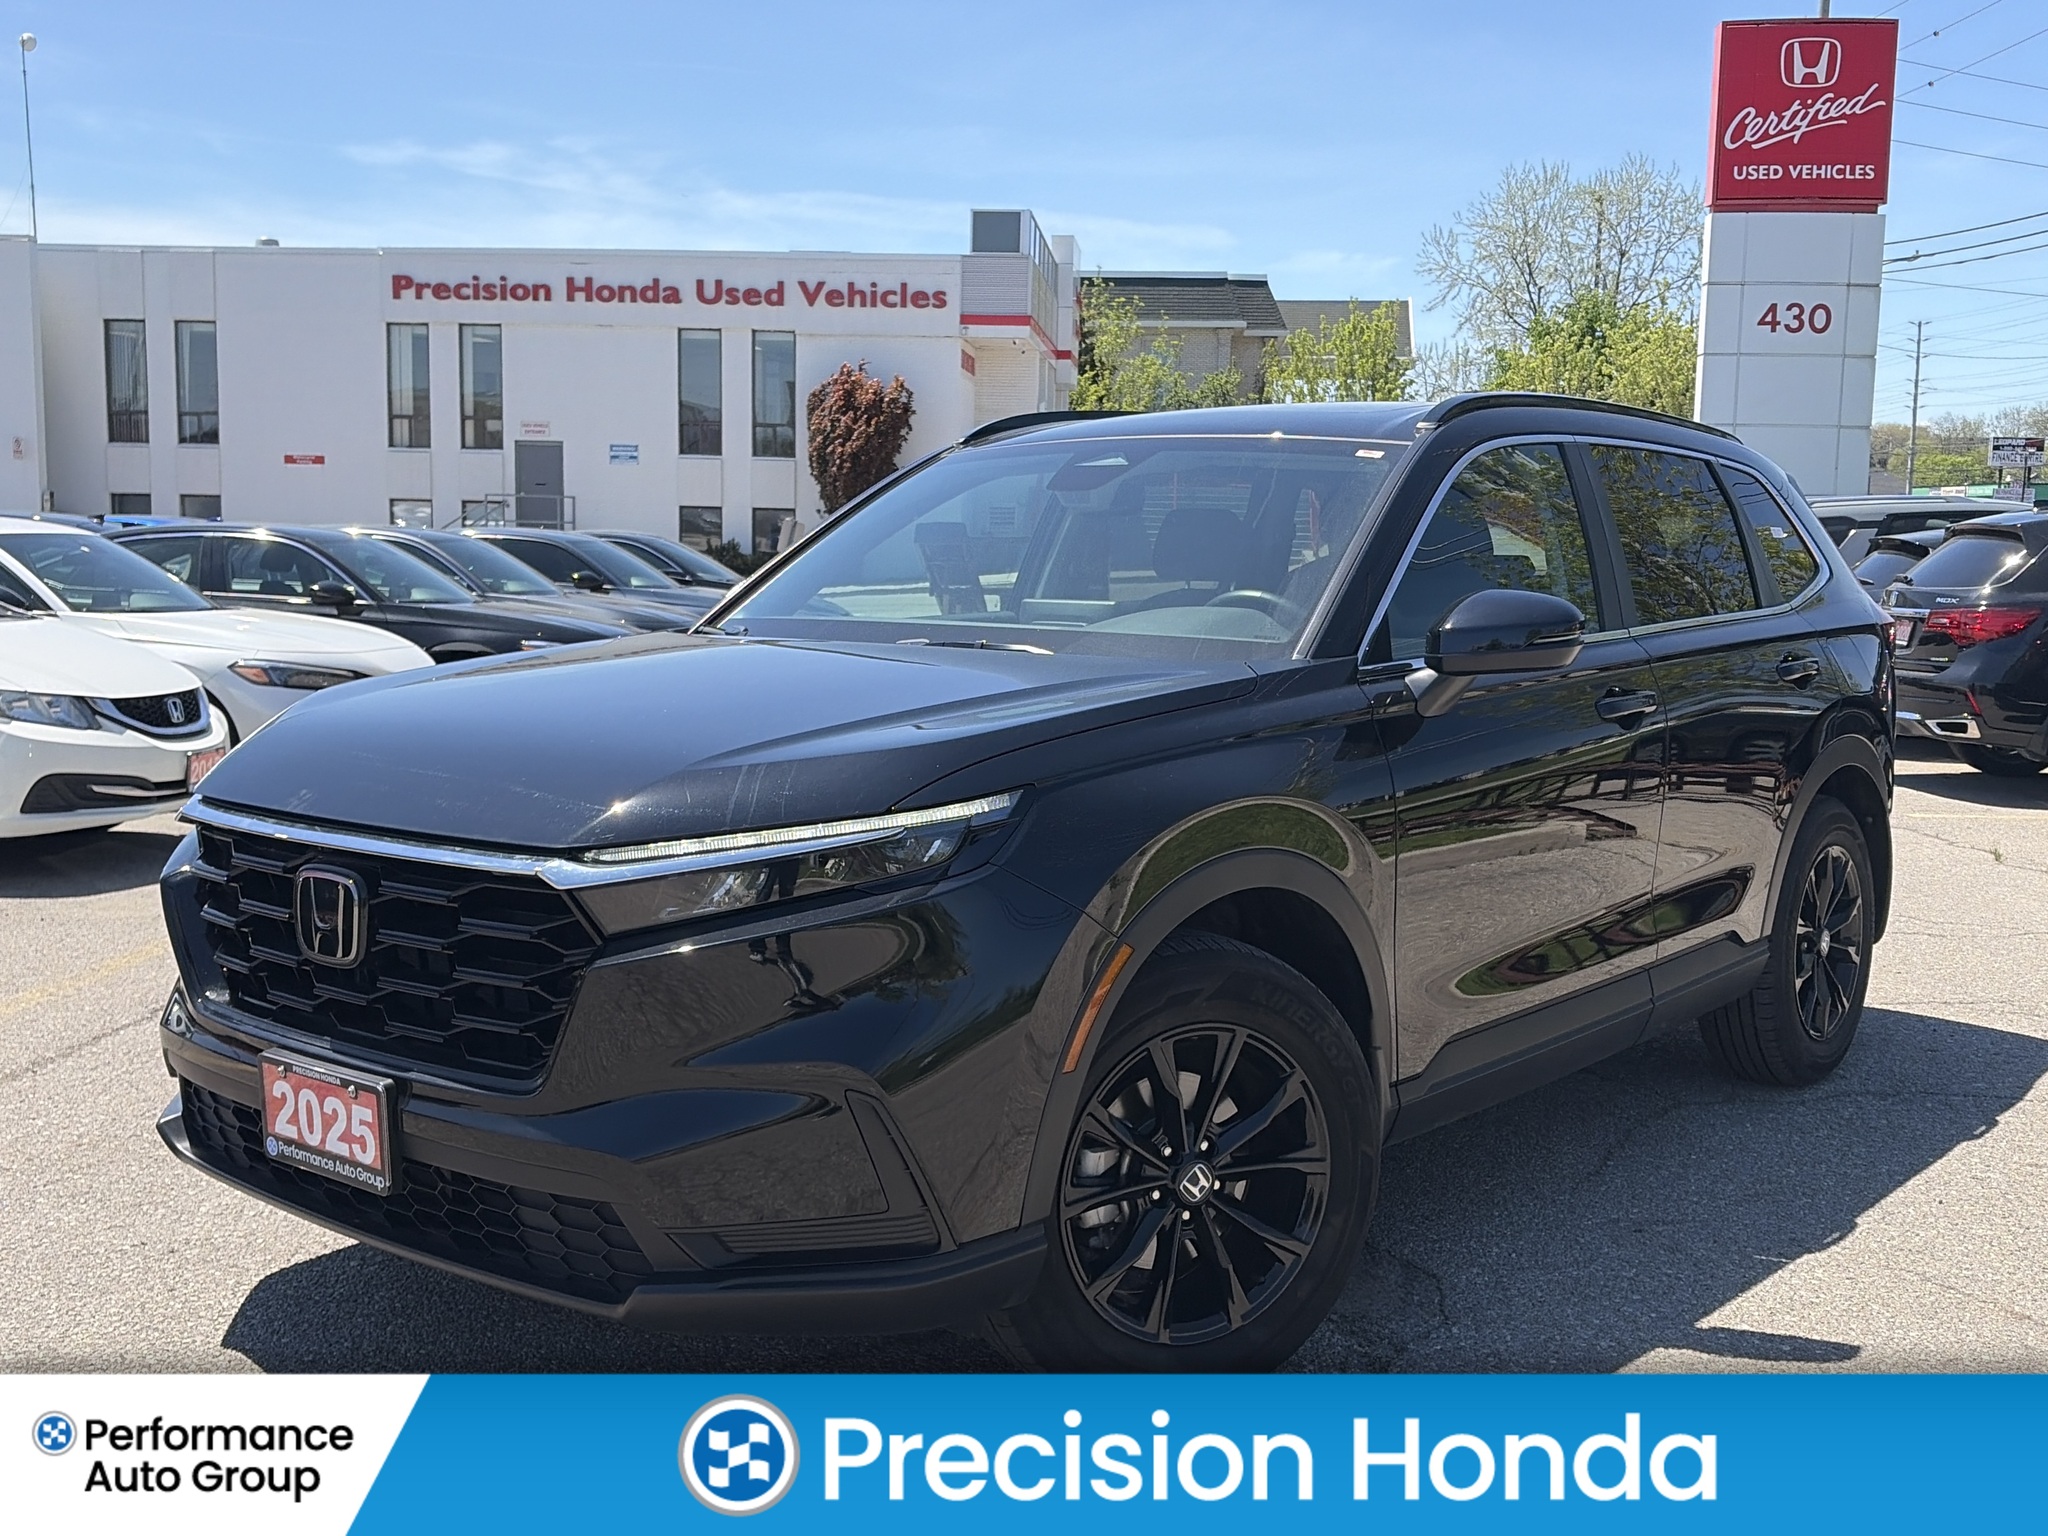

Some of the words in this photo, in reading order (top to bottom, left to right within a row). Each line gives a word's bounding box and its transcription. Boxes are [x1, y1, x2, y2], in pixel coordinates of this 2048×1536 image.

[1723, 82, 1886, 150] Certified
[1733, 165, 1783, 181] USED
[1788, 164, 1876, 181] VEHICLES
[391, 273, 552, 302] Precision
[566, 276, 682, 304] Honda
[695, 279, 785, 307] Used
[798, 280, 948, 309] Vehicles
[1757, 302, 1832, 334] 430
[1992, 452, 2018, 463] FINANCE
[2019, 452, 2043, 463] CNTRE
[191, 755, 221, 784] 201
[292, 1065, 320, 1080] PRECISION
[320, 1073, 341, 1086] HONDA
[272, 1080, 376, 1166] 2025
[278, 1141, 335, 1171] Performance
[335, 1160, 356, 1179] Auto
[356, 1168, 385, 1191] Group
